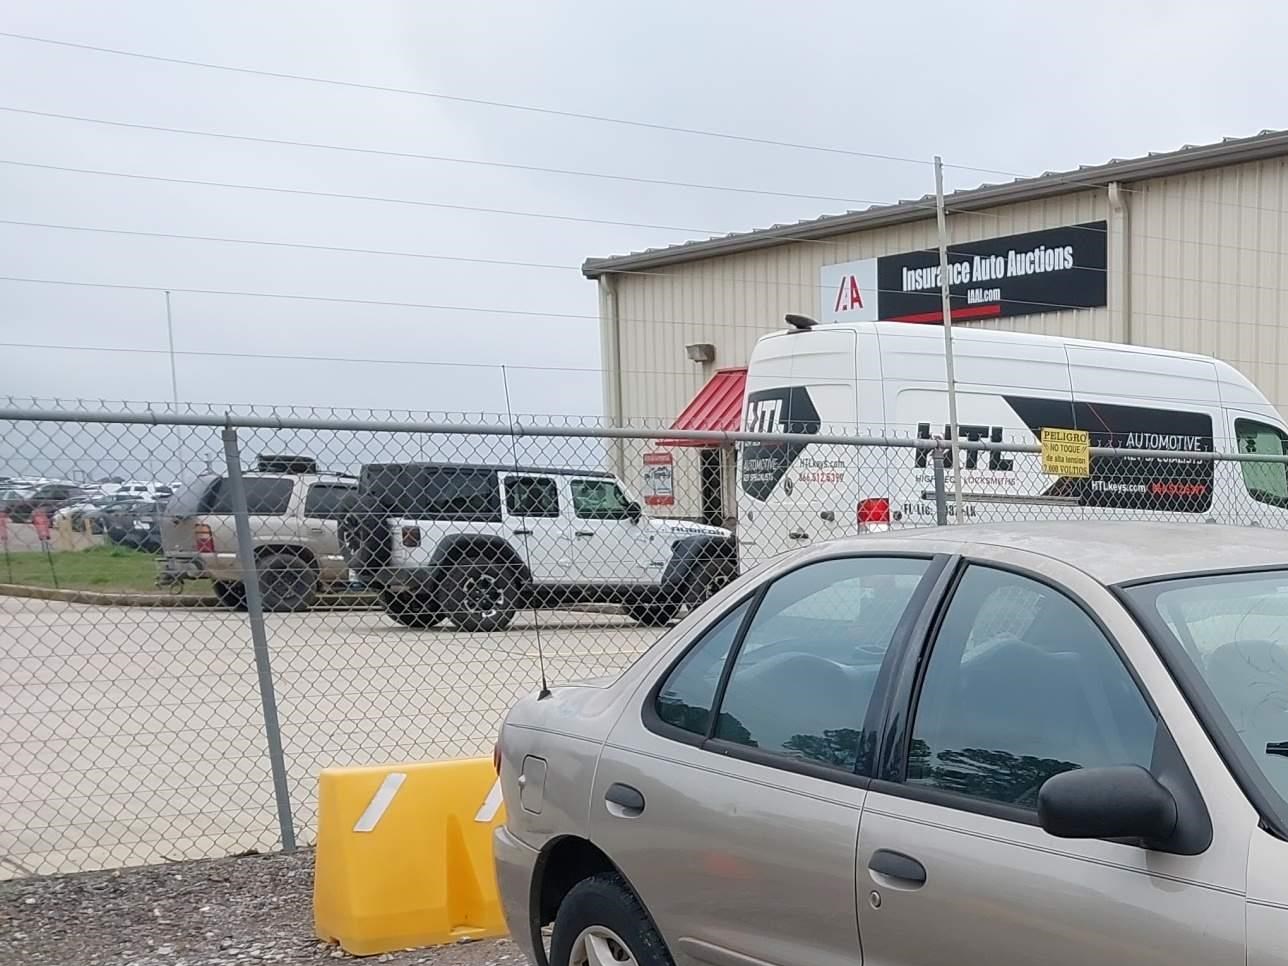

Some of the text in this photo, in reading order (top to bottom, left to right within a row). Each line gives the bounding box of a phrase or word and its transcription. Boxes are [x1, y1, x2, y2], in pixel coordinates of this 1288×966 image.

[902, 245, 1073, 292] Insurance Auto Auctions
[1044, 431, 1087, 442] PELIGRO
[1126, 432, 1201, 451] AUTOMOTIVE
[1050, 444, 1081, 454] NO TOQUE
[1060, 465, 1088, 475] VOLTIOS
